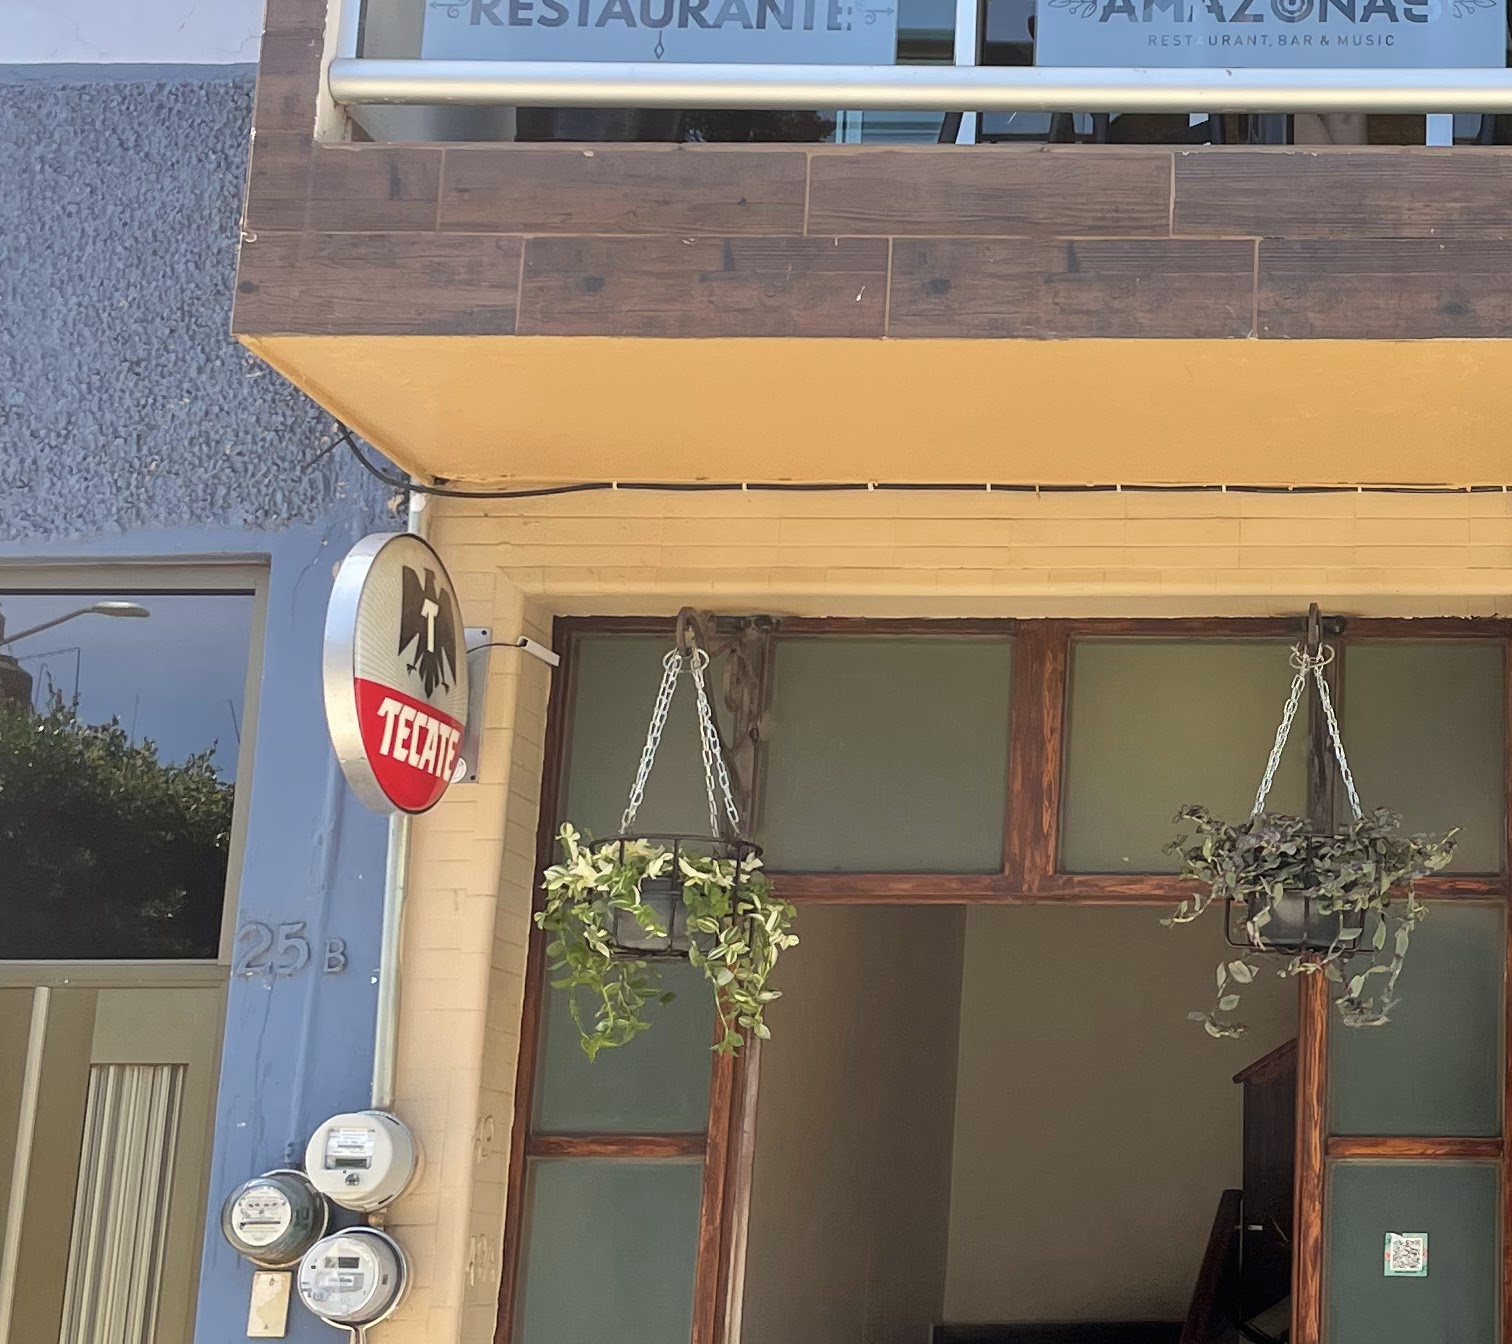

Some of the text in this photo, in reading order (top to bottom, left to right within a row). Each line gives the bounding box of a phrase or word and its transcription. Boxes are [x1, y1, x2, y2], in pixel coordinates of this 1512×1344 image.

[1278, 33, 1313, 47] BAR
[1320, 34, 1330, 47] &
[1337, 34, 1396, 47] MUSIC
[377, 696, 461, 783] TECATE
